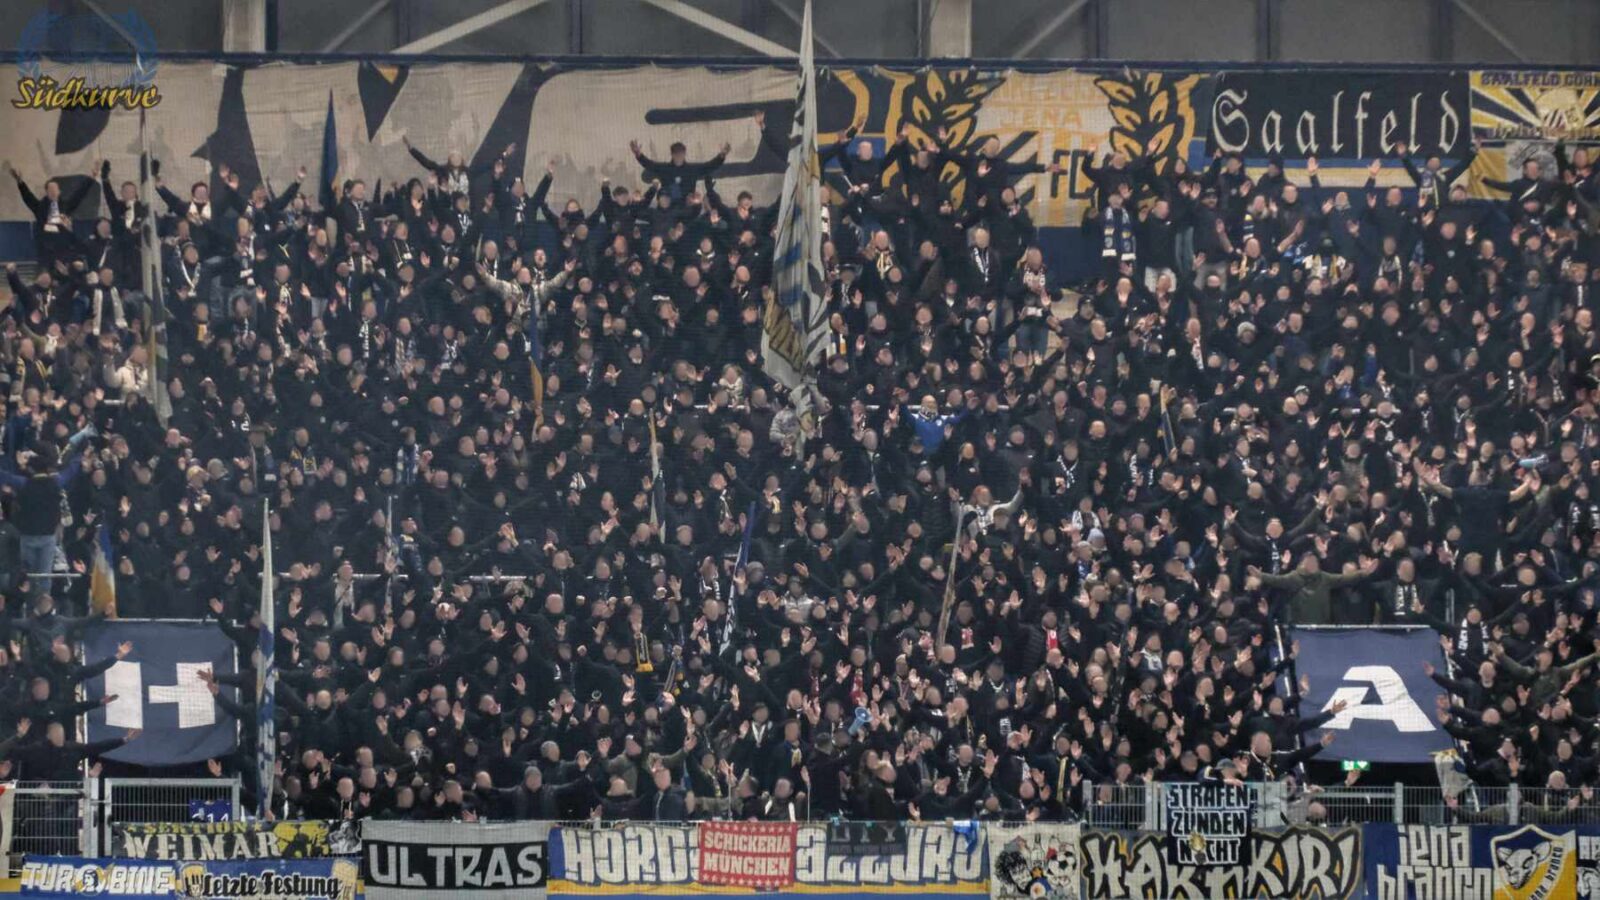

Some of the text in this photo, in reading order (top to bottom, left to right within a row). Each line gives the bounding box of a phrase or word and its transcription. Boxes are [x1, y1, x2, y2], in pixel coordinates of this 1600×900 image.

[1212, 89, 1460, 160] Saalfeld
[1168, 783, 1249, 809] STRAFEN
[1171, 807, 1247, 837] ZÜNDEN
[122, 829, 283, 862] WEIMAR
[704, 830, 791, 853] SCHICKERIA
[1177, 838, 1240, 864] NCHT
[369, 843, 543, 887] ULTRAS
[703, 850, 790, 876] MÜNCHEN
[202, 870, 341, 899] Letzte Festung
